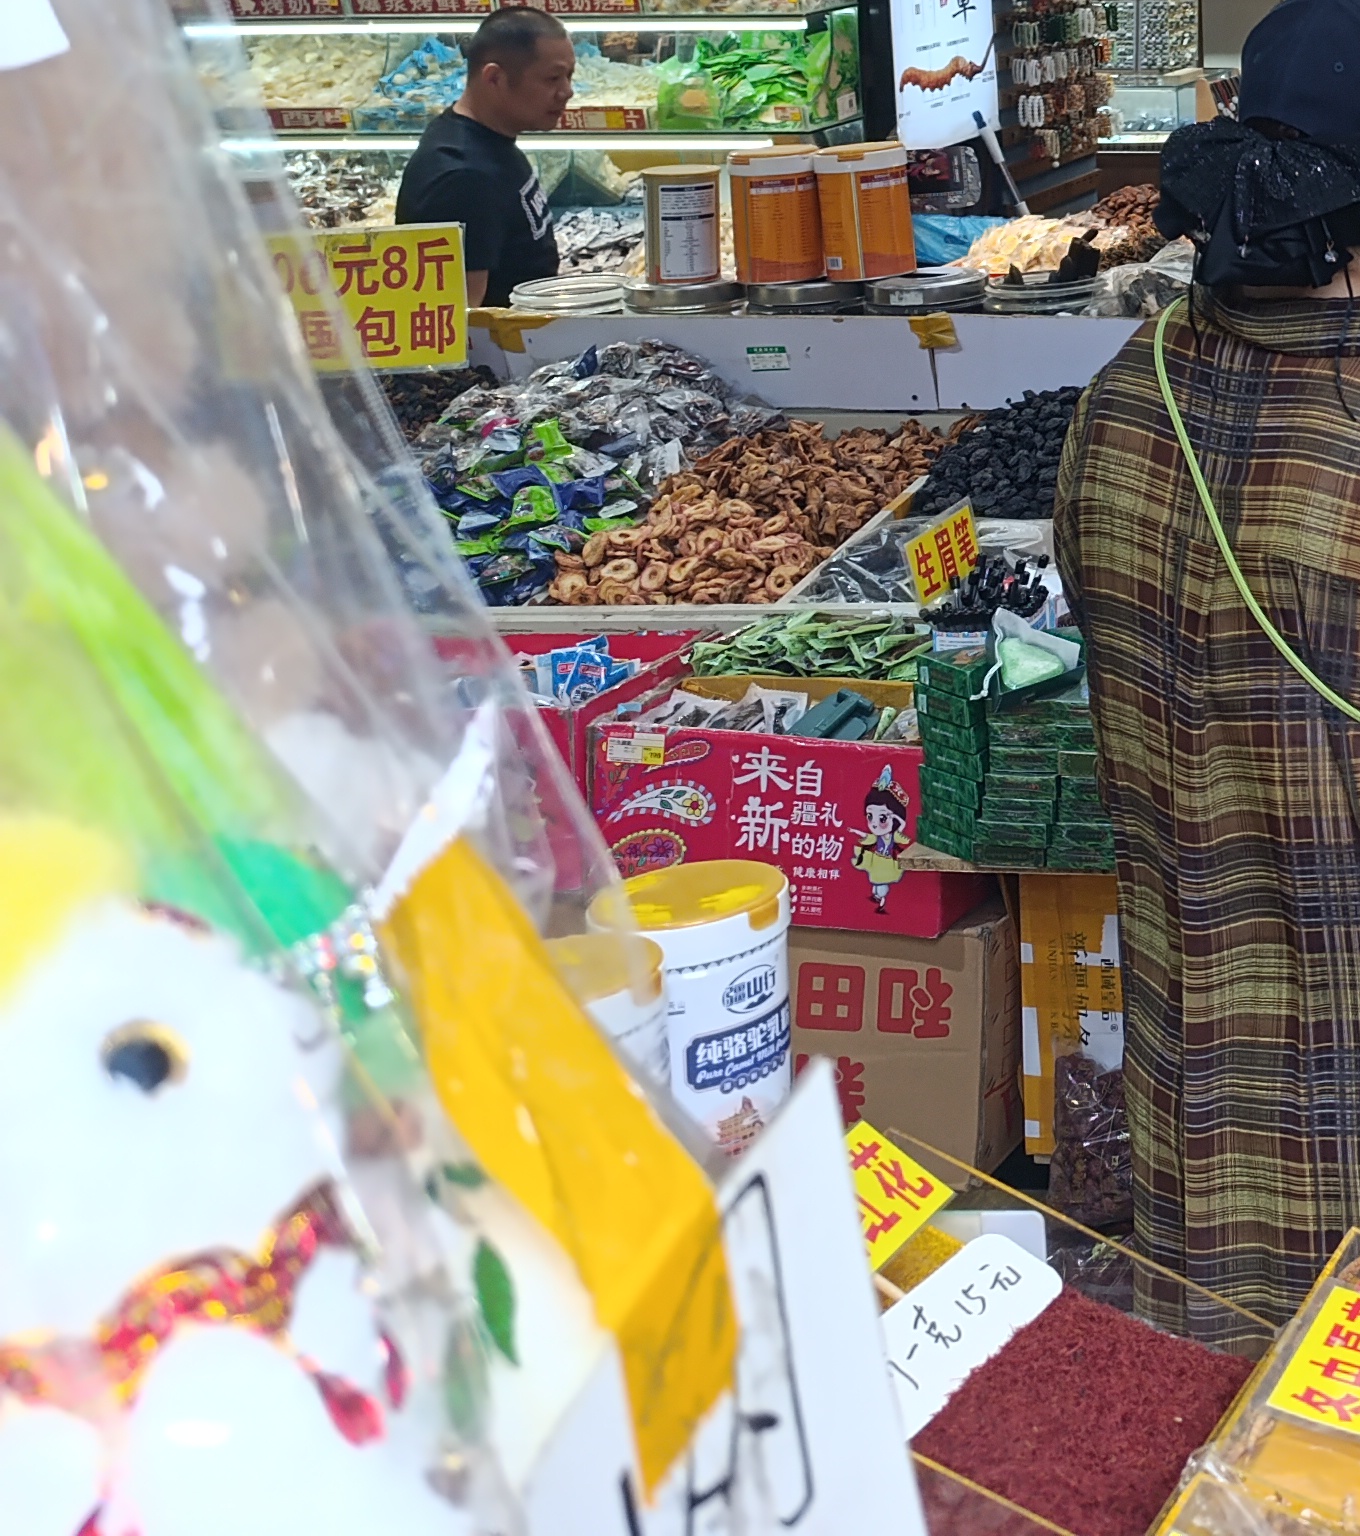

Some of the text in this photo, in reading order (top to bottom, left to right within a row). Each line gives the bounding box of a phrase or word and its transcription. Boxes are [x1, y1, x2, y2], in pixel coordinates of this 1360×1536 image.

[262, 237, 456, 296] 00元8斤
[285, 302, 457, 359] 国包邮
[914, 514, 979, 597] 生眉笔
[733, 746, 824, 797] 来自
[796, 961, 954, 1039] 和田
